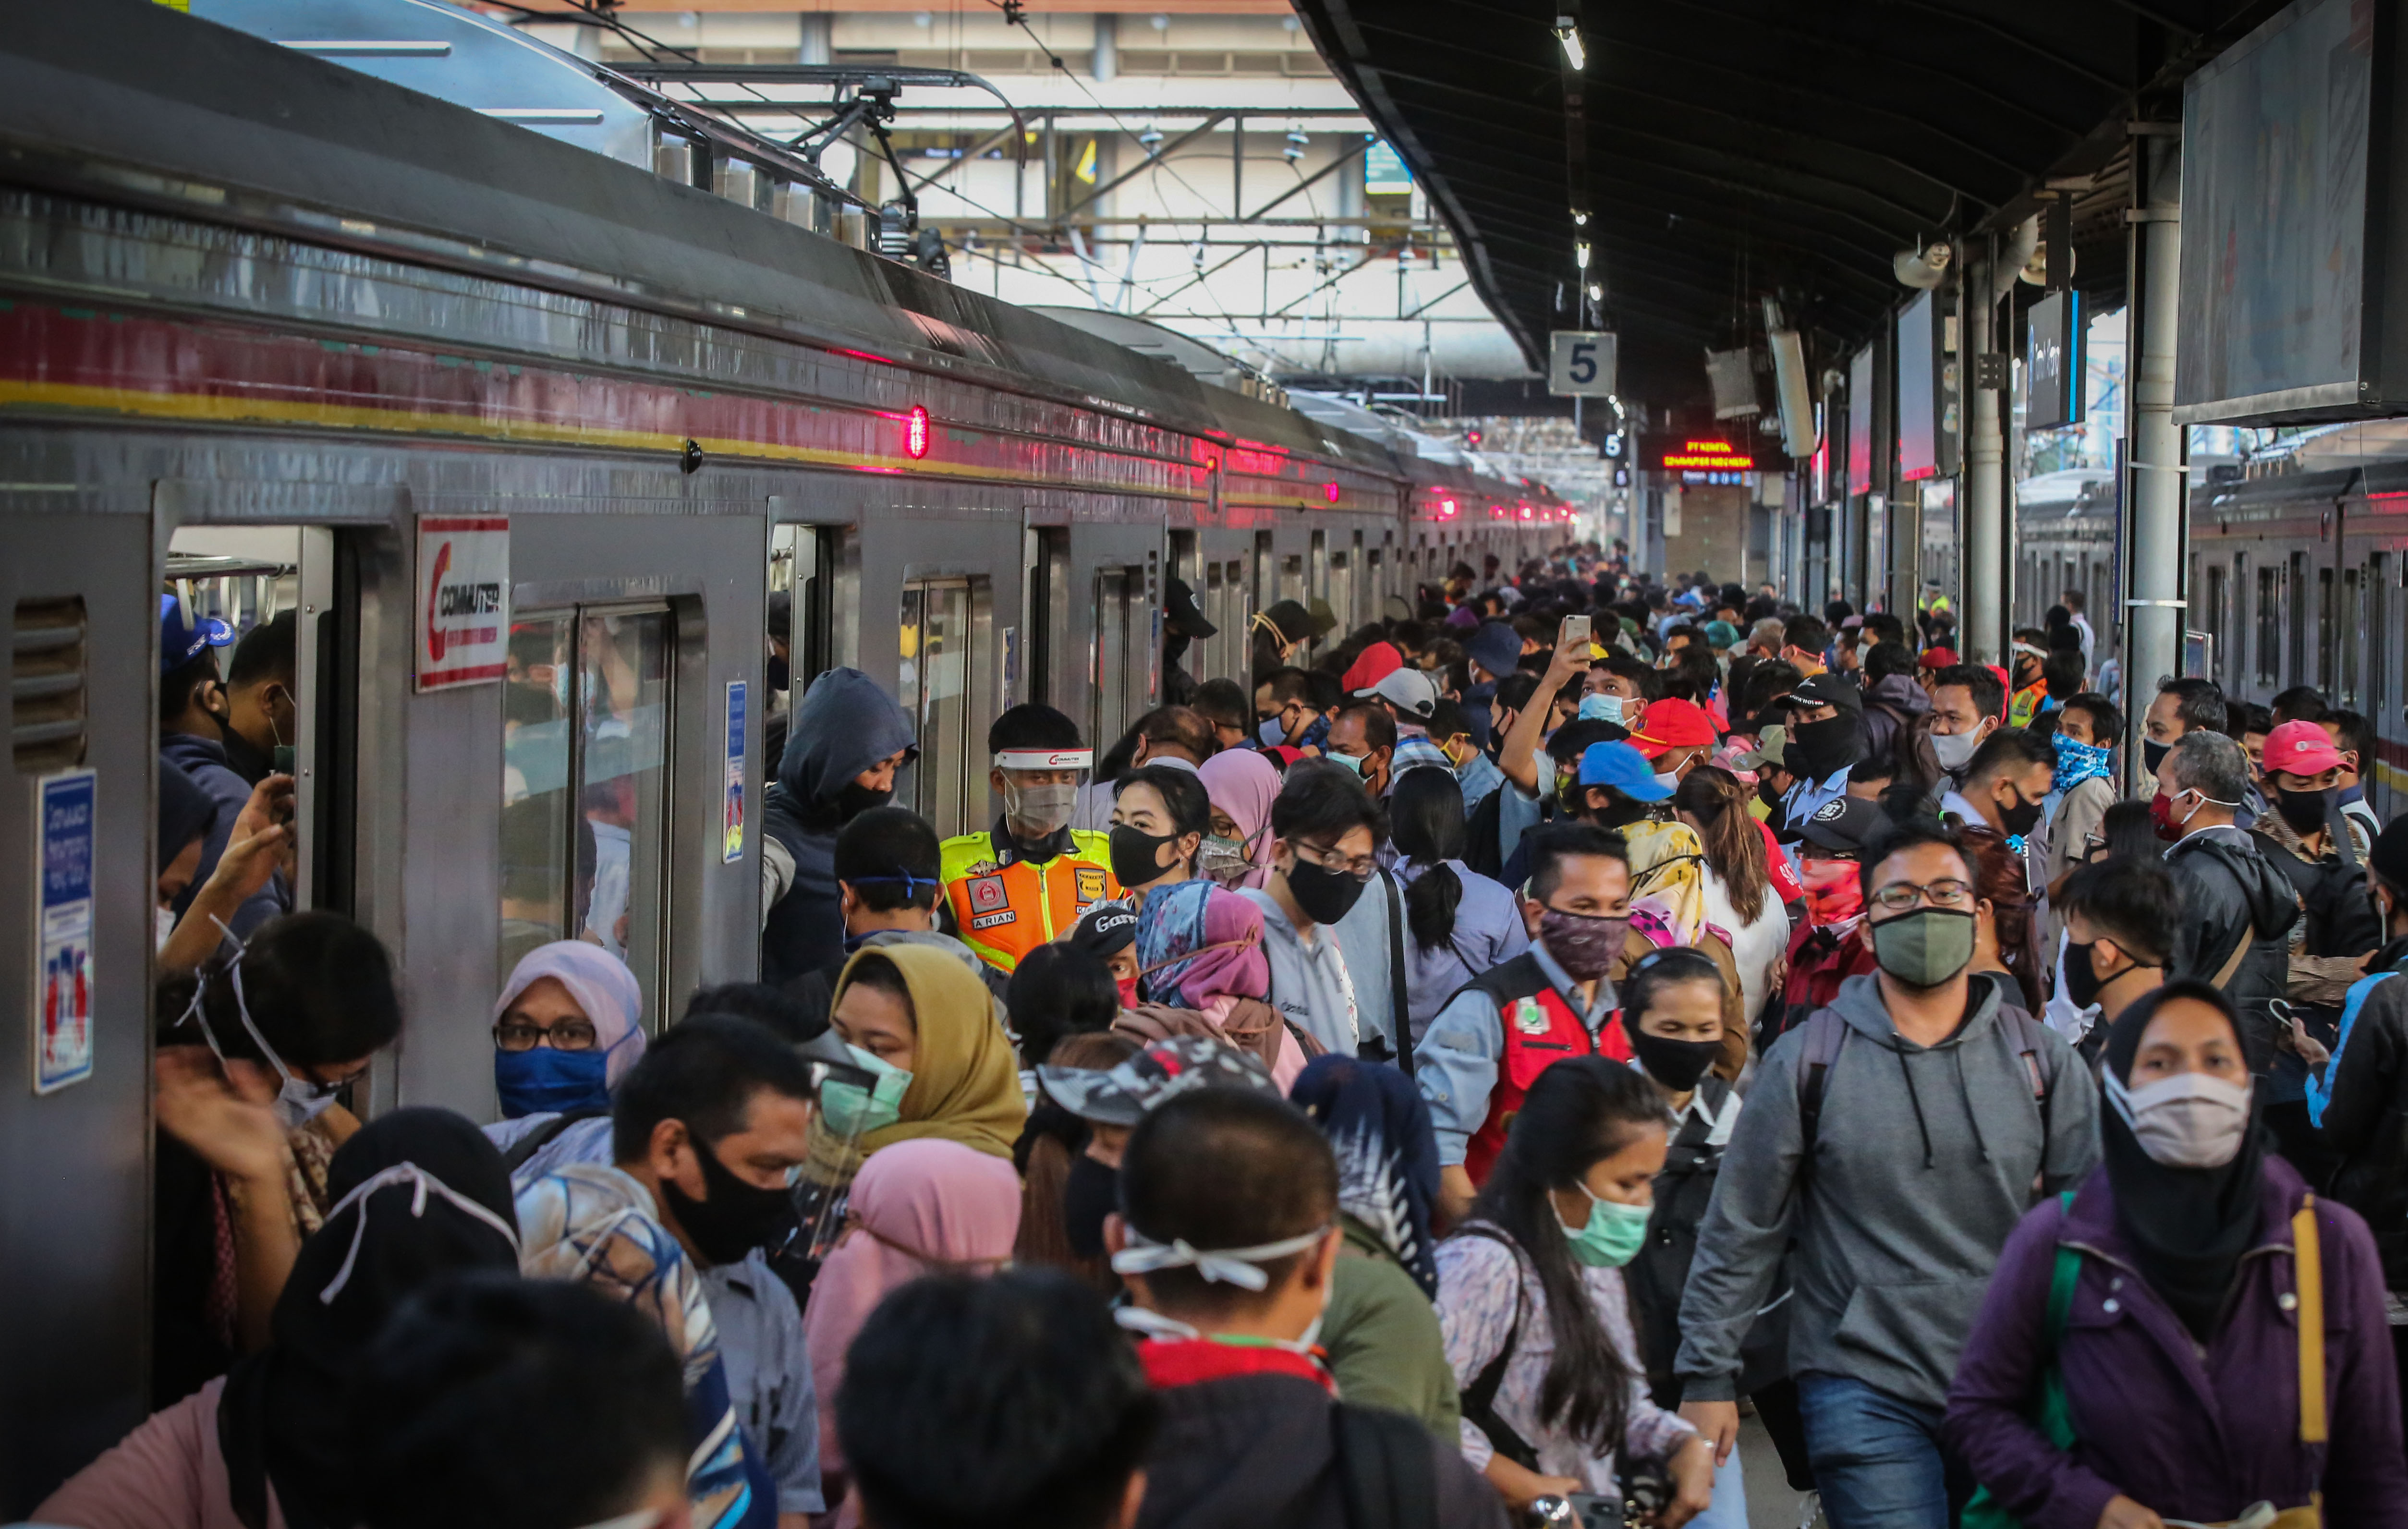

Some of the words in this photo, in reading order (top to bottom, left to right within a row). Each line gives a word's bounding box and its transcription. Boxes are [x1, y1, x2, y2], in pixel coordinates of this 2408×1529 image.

[1569, 343, 1597, 384] 5
[1605, 434, 1621, 457] 5
[440, 582, 500, 617] COMMUTER
